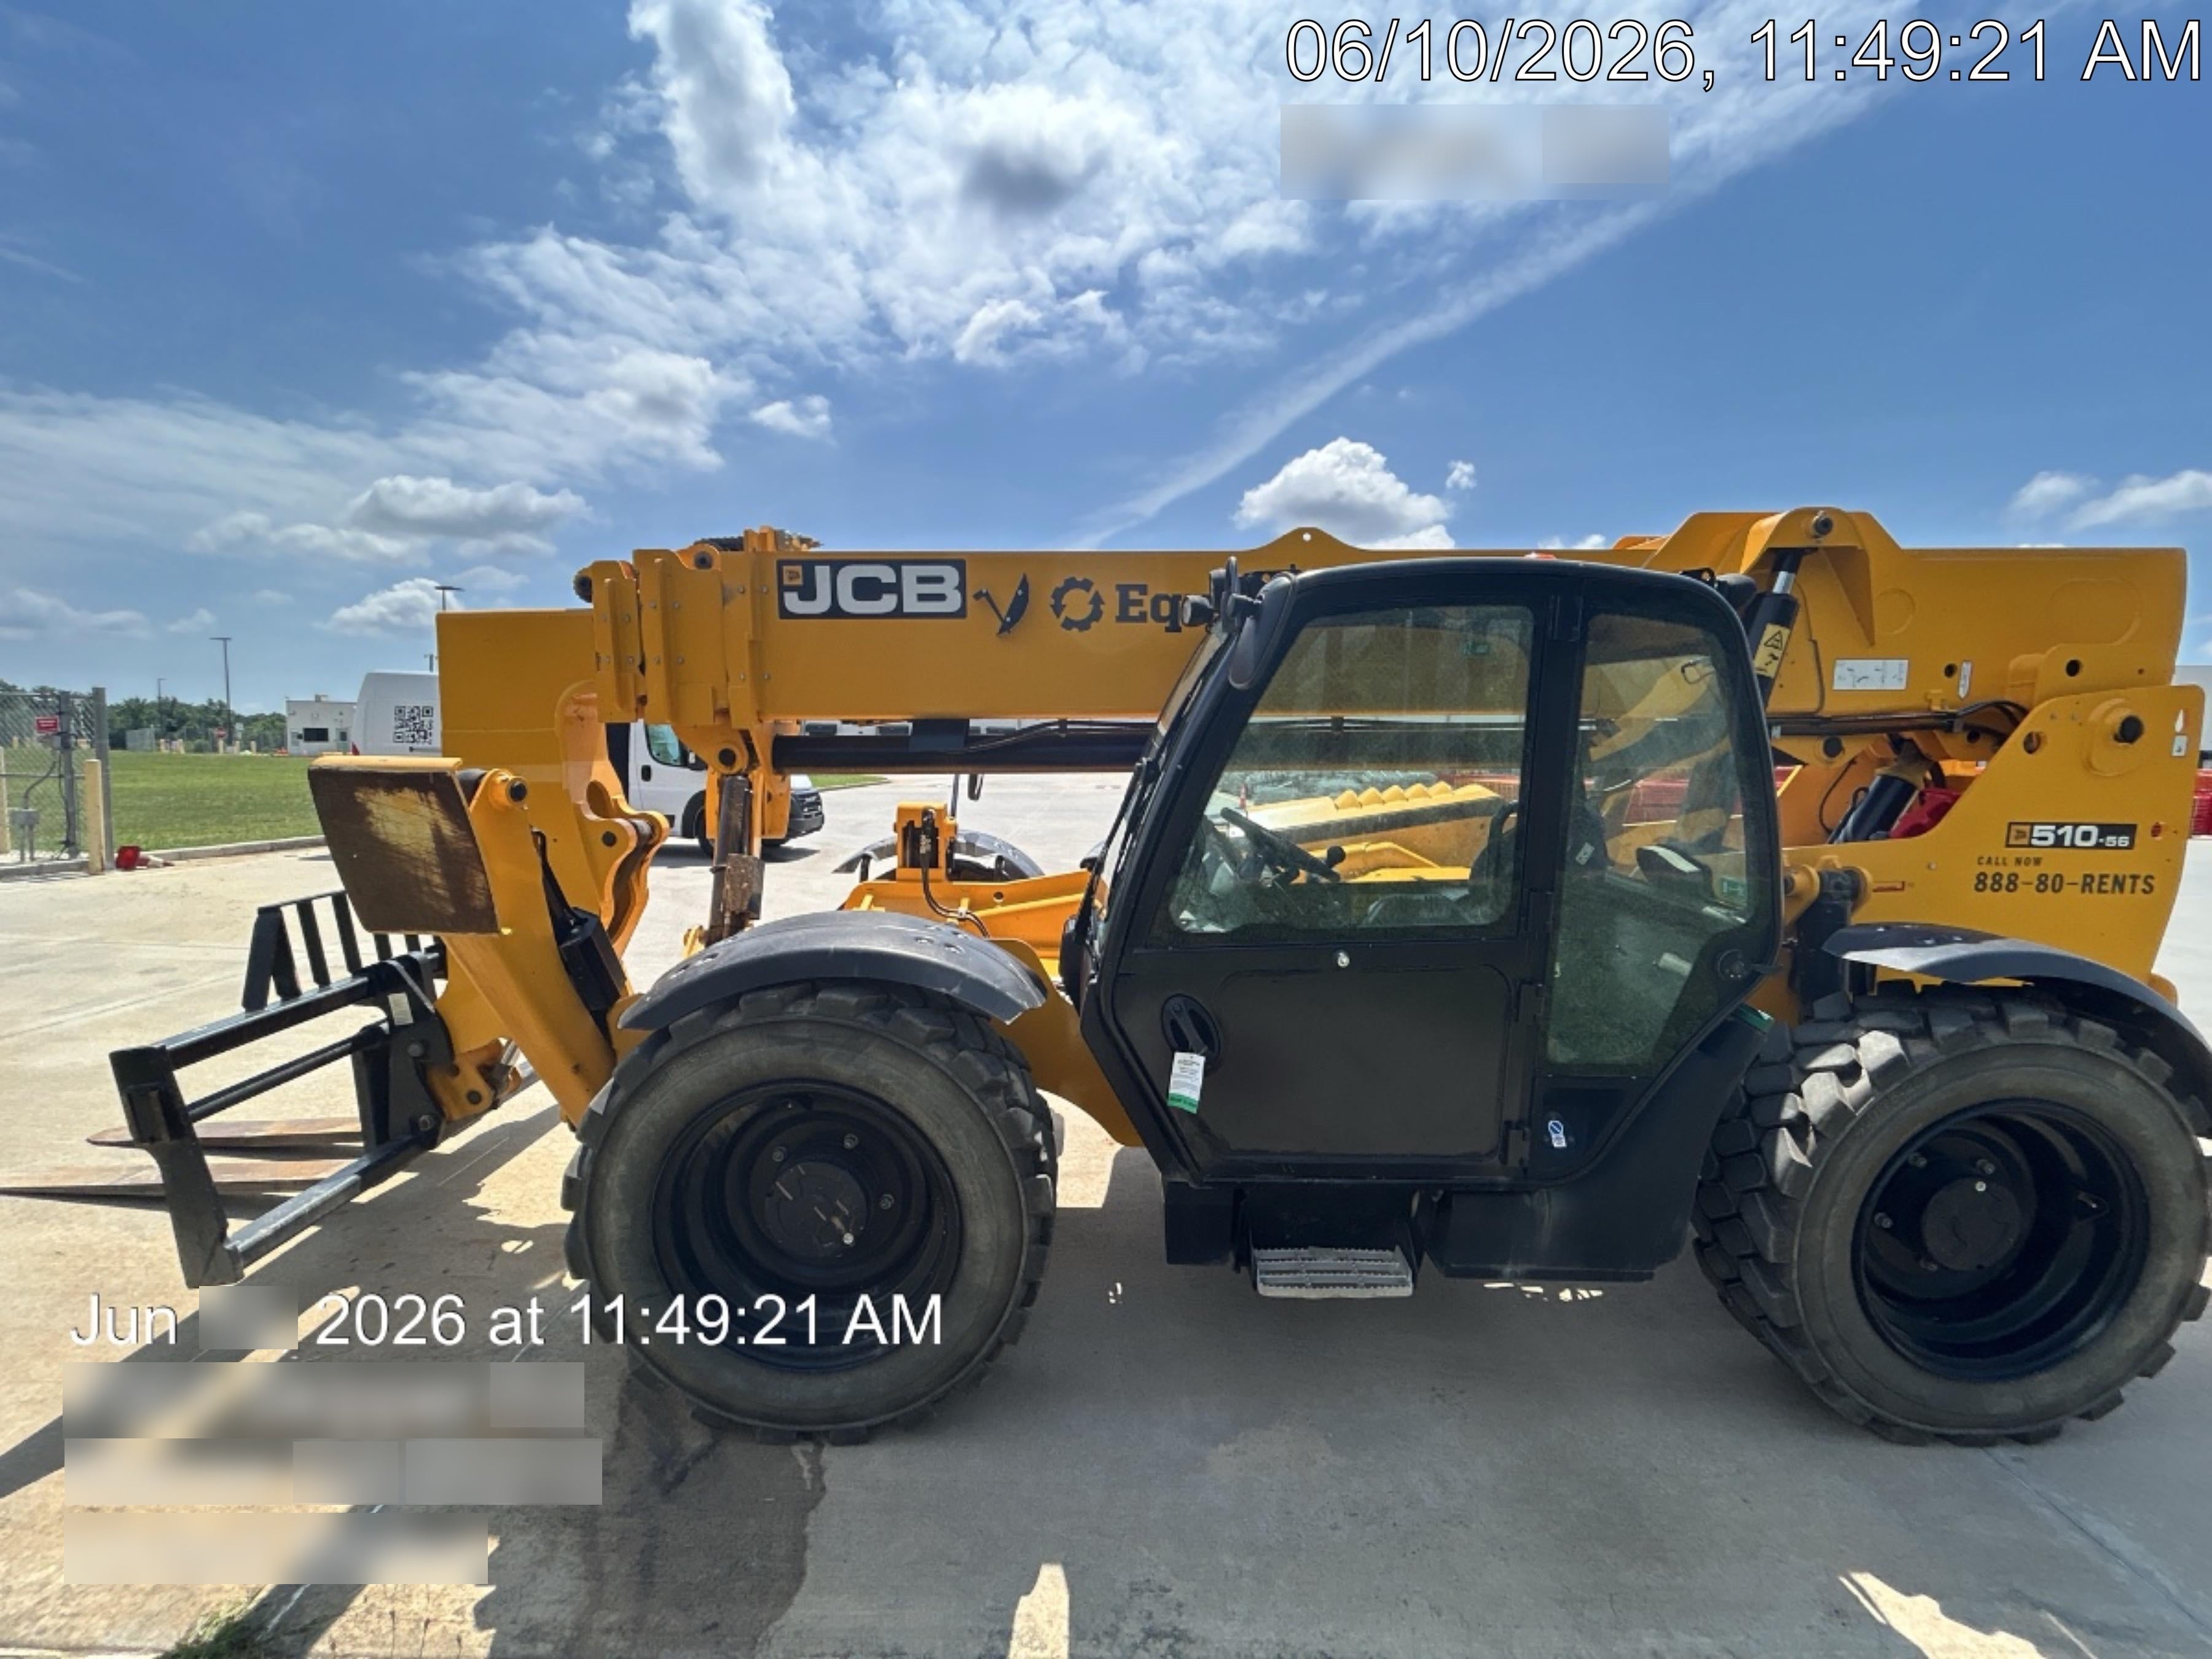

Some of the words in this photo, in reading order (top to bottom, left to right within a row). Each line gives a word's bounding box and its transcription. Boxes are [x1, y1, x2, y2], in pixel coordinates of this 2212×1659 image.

[783, 565, 961, 614] JCB
[1115, 584, 1182, 633] Eq
[2030, 825, 2130, 847] 510-56
[1977, 856, 2007, 866] CALL
[2014, 857, 2042, 867] NOW
[1974, 871, 2155, 895] 888-80-RENTS
